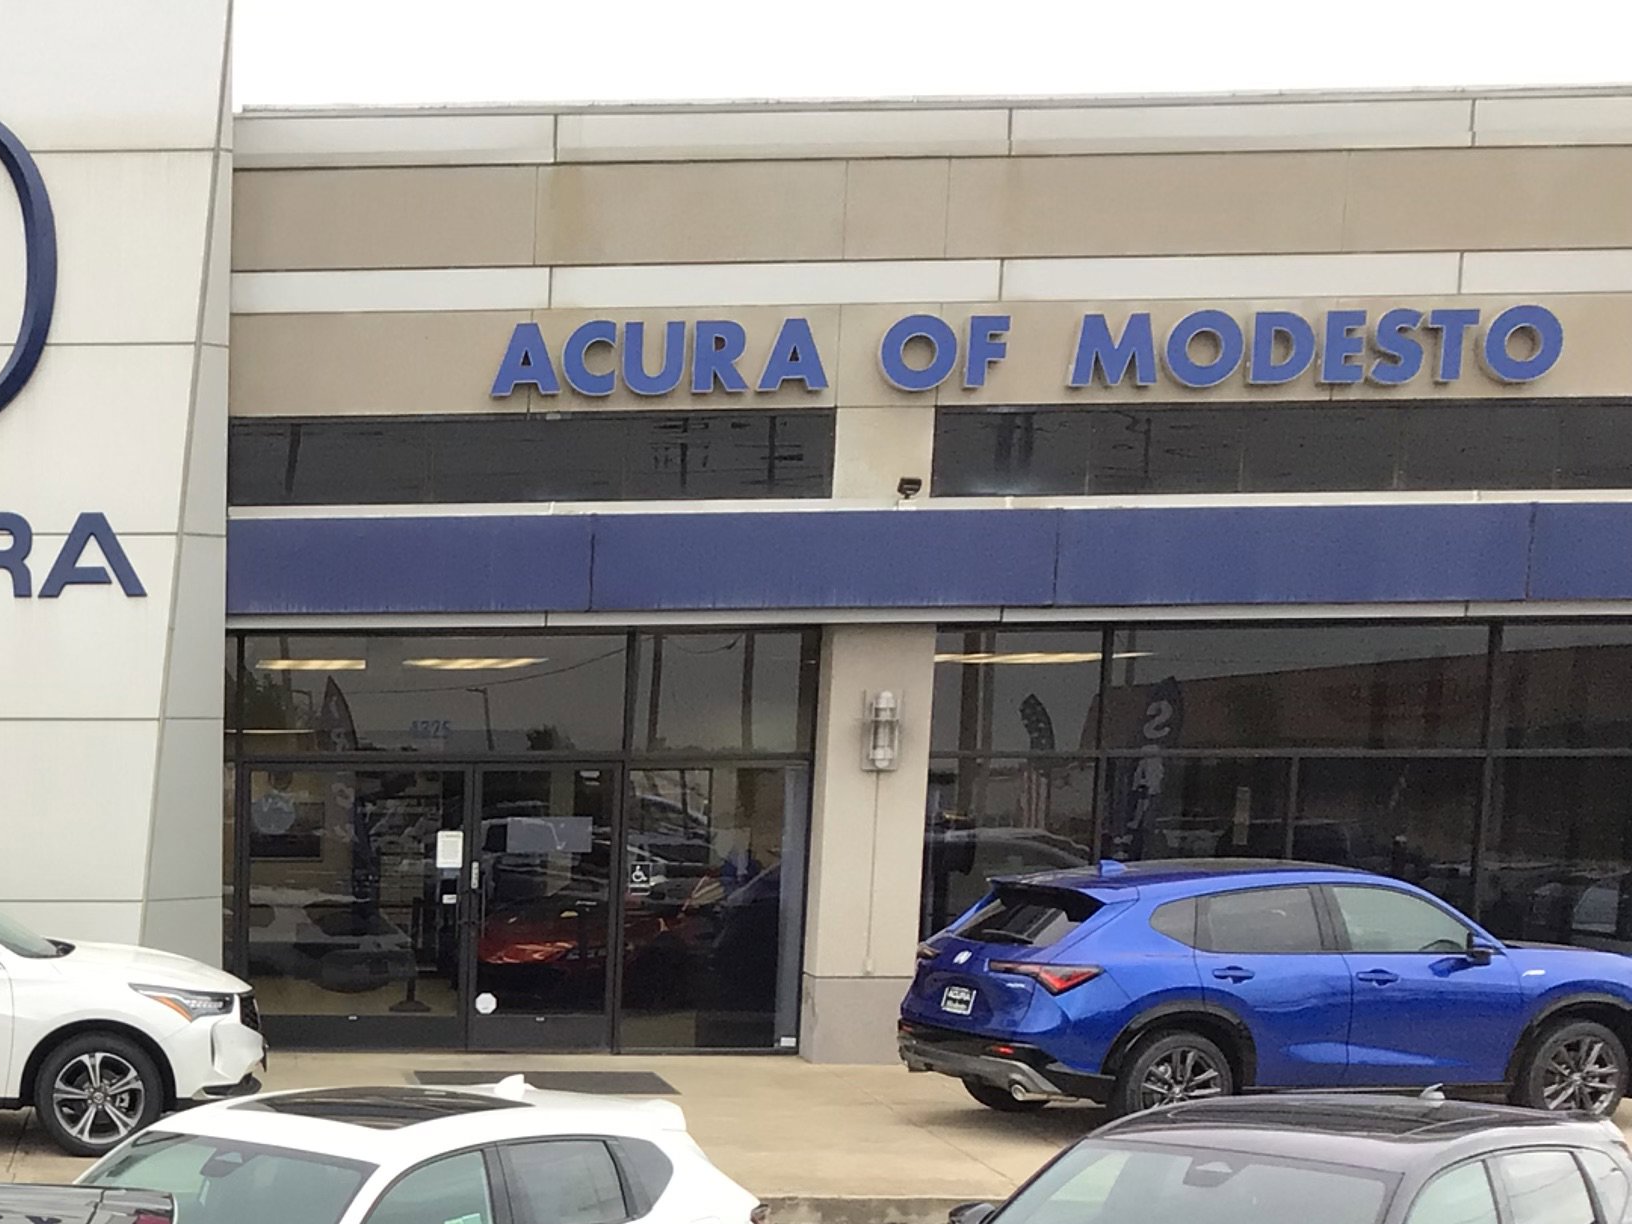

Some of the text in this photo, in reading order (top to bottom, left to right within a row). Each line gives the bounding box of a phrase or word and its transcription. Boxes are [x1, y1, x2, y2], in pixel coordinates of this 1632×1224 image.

[489, 304, 1565, 397] ACURA OF MODESTO
